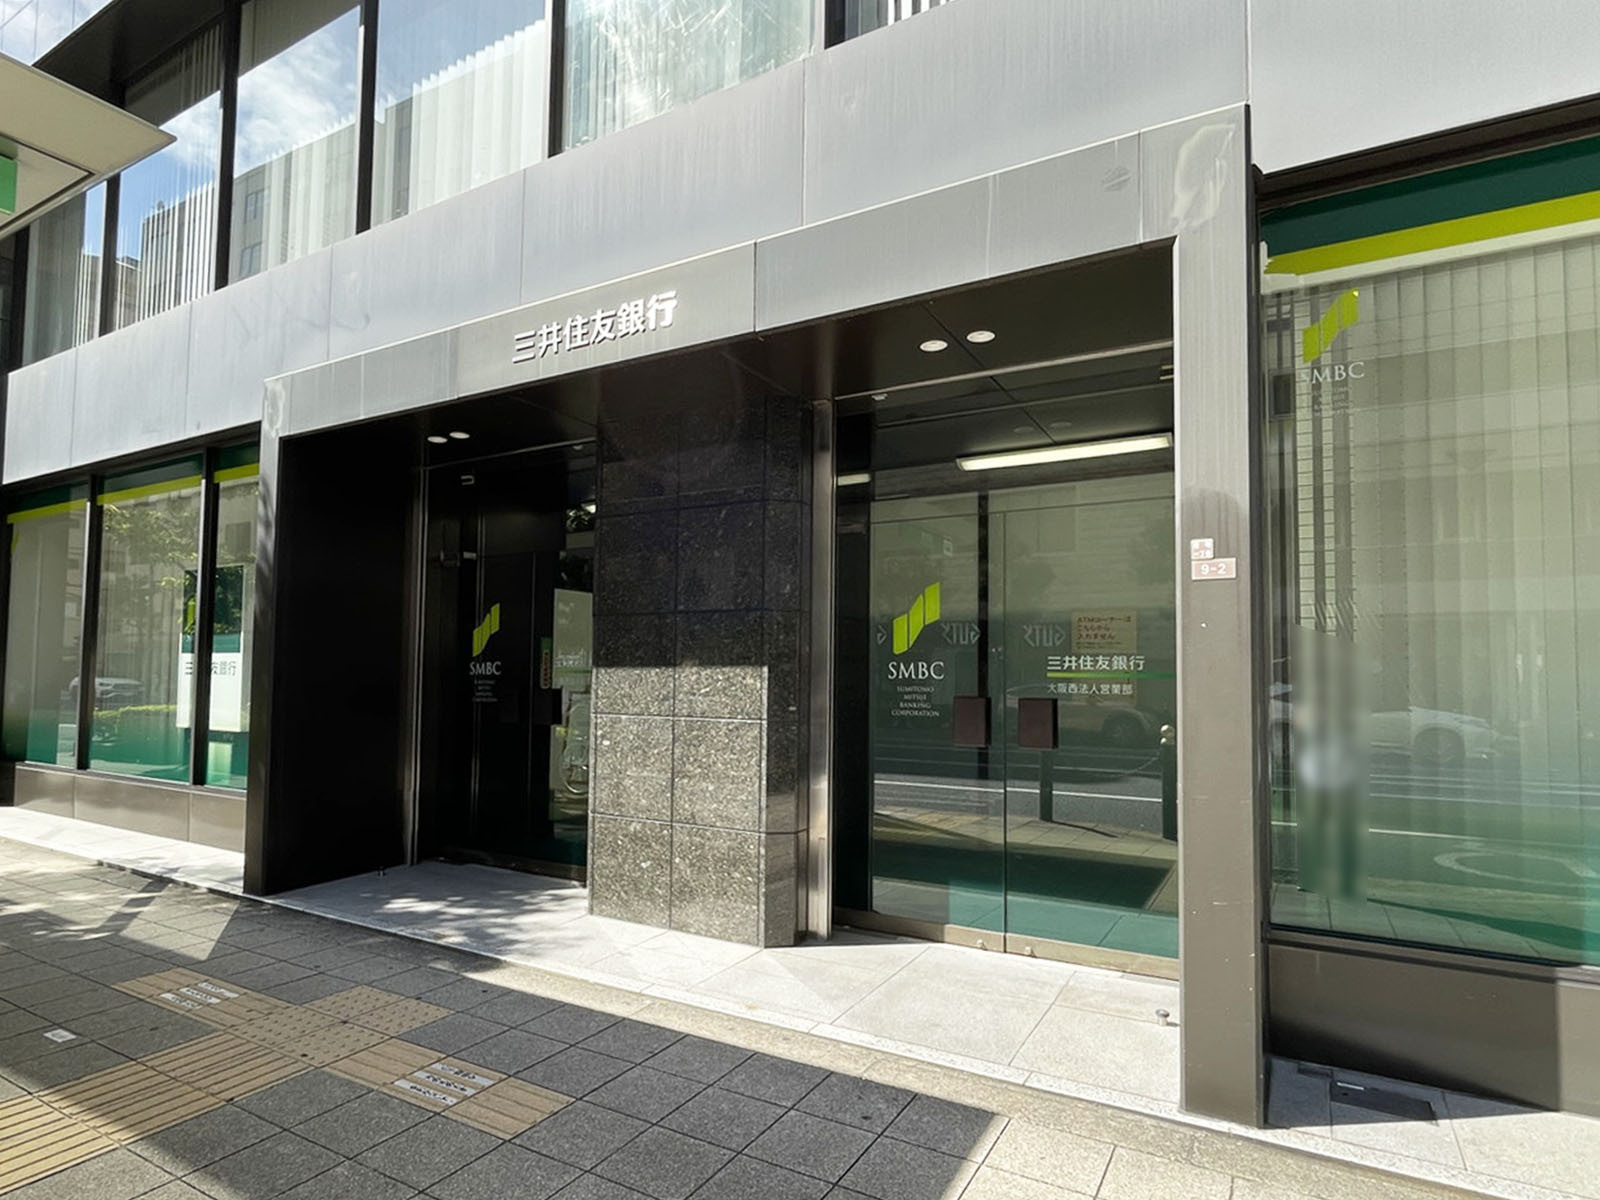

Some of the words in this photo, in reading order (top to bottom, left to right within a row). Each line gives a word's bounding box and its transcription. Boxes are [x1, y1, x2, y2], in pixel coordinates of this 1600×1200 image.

[512, 290, 678, 363] 三井住友銀行
[1201, 562, 1227, 575] 9-2
[469, 661, 502, 676] SMBC
[888, 661, 945, 680] SMBC
[1047, 655, 1145, 671] 三井住友銀行
